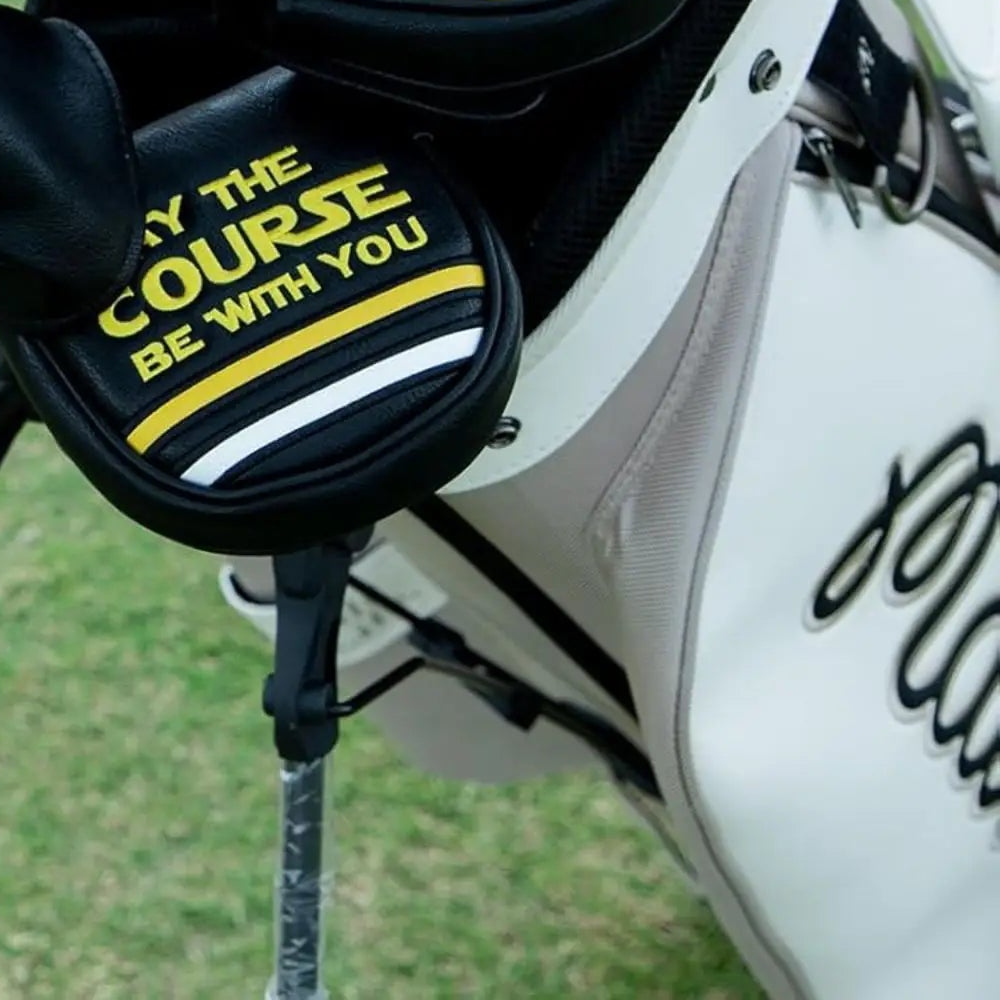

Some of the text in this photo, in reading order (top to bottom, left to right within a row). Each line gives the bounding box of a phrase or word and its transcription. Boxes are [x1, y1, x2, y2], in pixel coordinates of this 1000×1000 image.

[98, 163, 412, 337] COURSE
[198, 145, 313, 210] THE
[130, 216, 429, 382] BE WITH YOU
